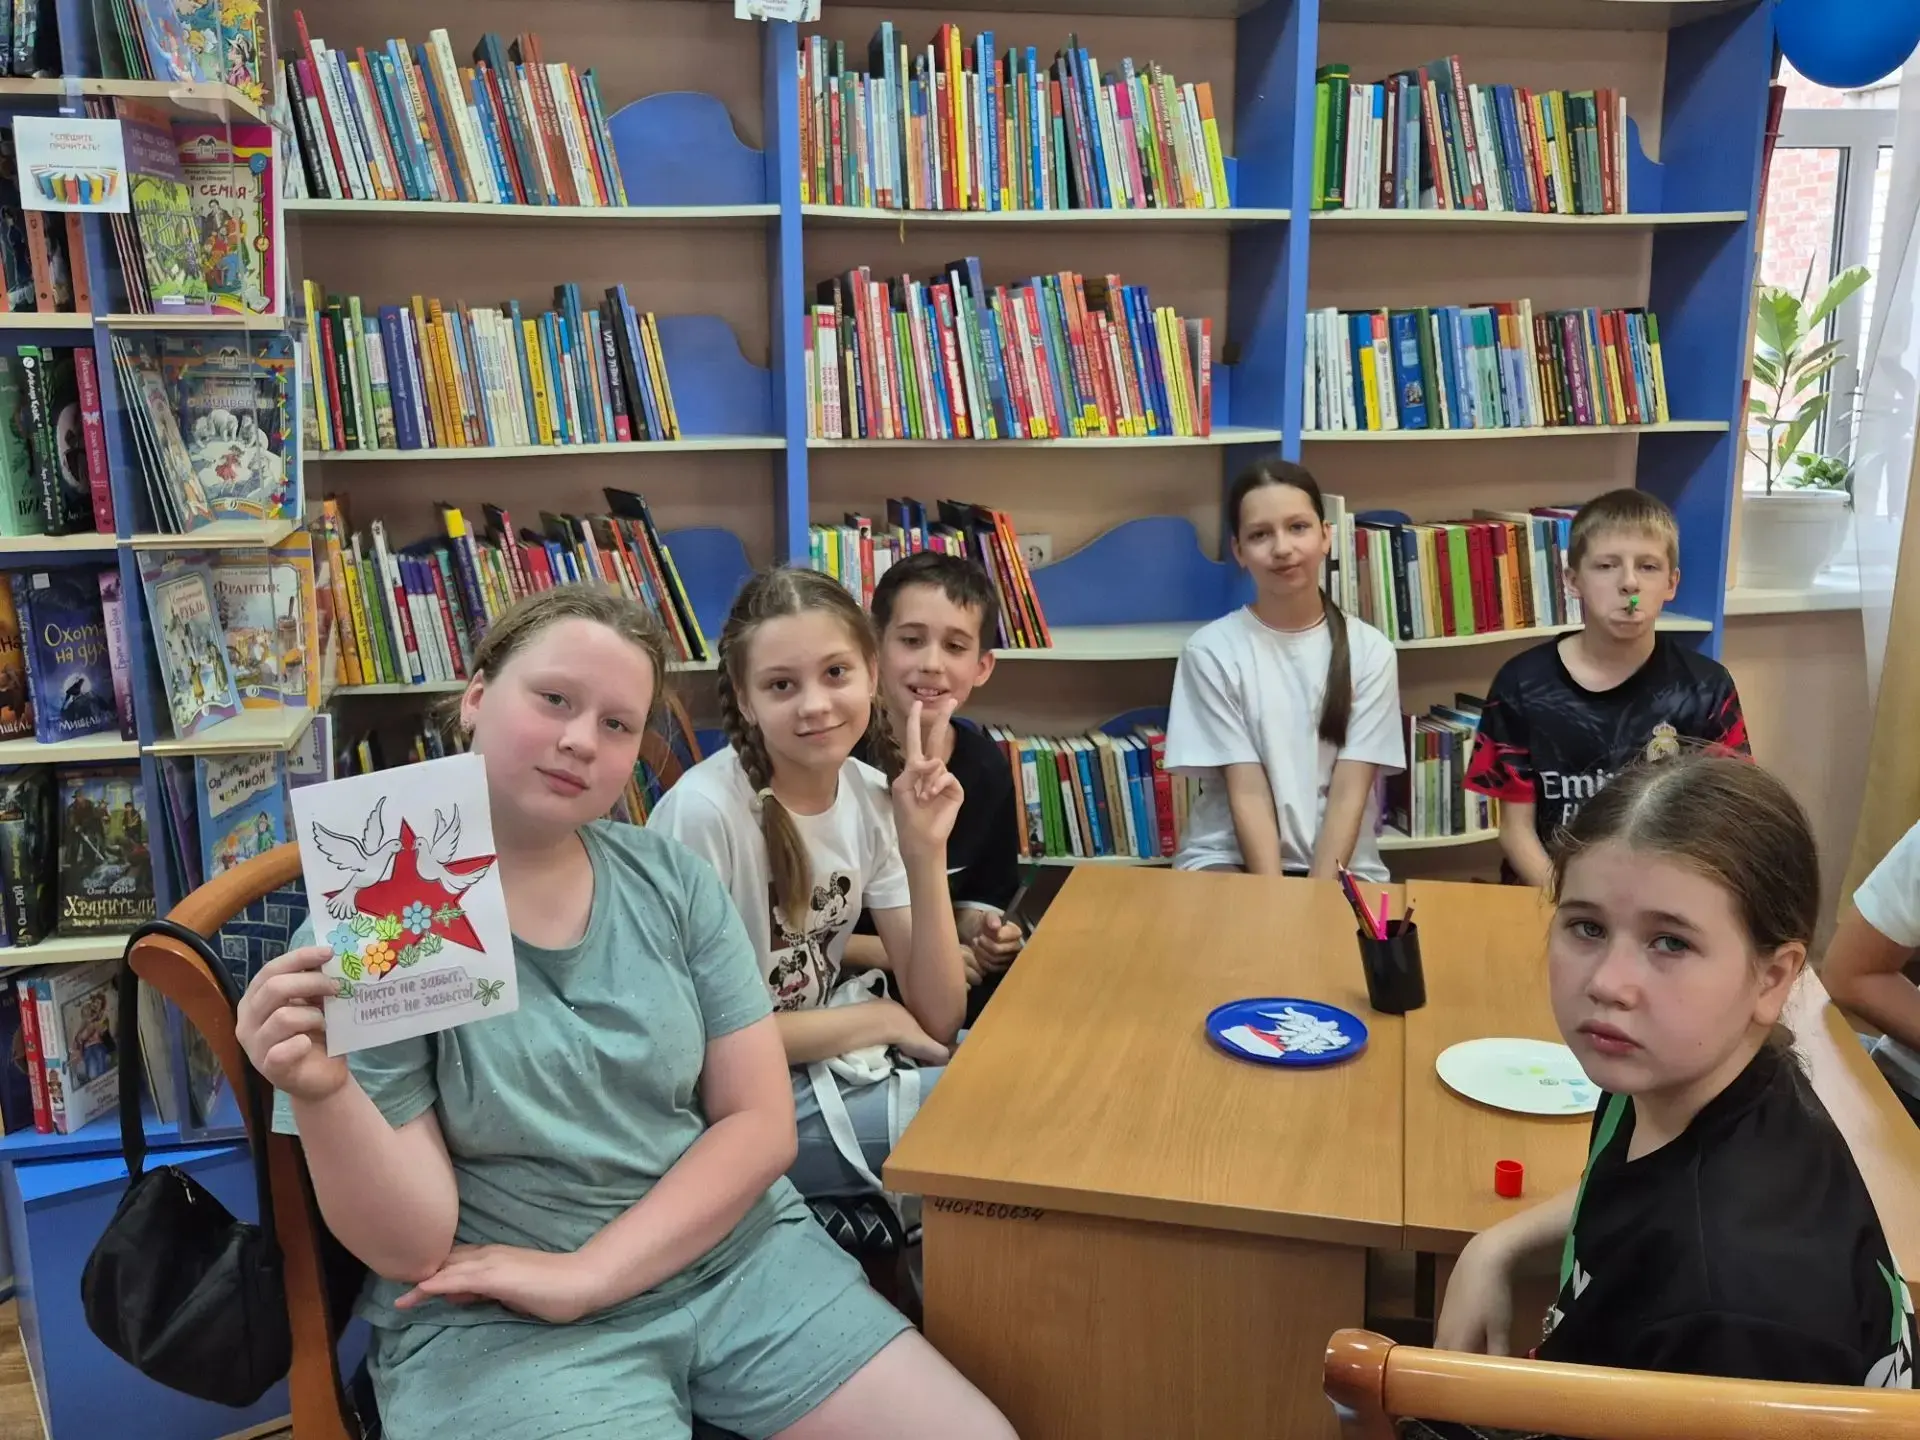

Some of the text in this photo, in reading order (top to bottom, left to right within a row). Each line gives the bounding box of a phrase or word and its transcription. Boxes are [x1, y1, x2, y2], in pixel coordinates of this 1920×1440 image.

[78, 641, 107, 668] дух
[1561, 803, 1579, 826] Fl
[400, 981, 416, 994] не
[404, 998, 420, 1012] не
